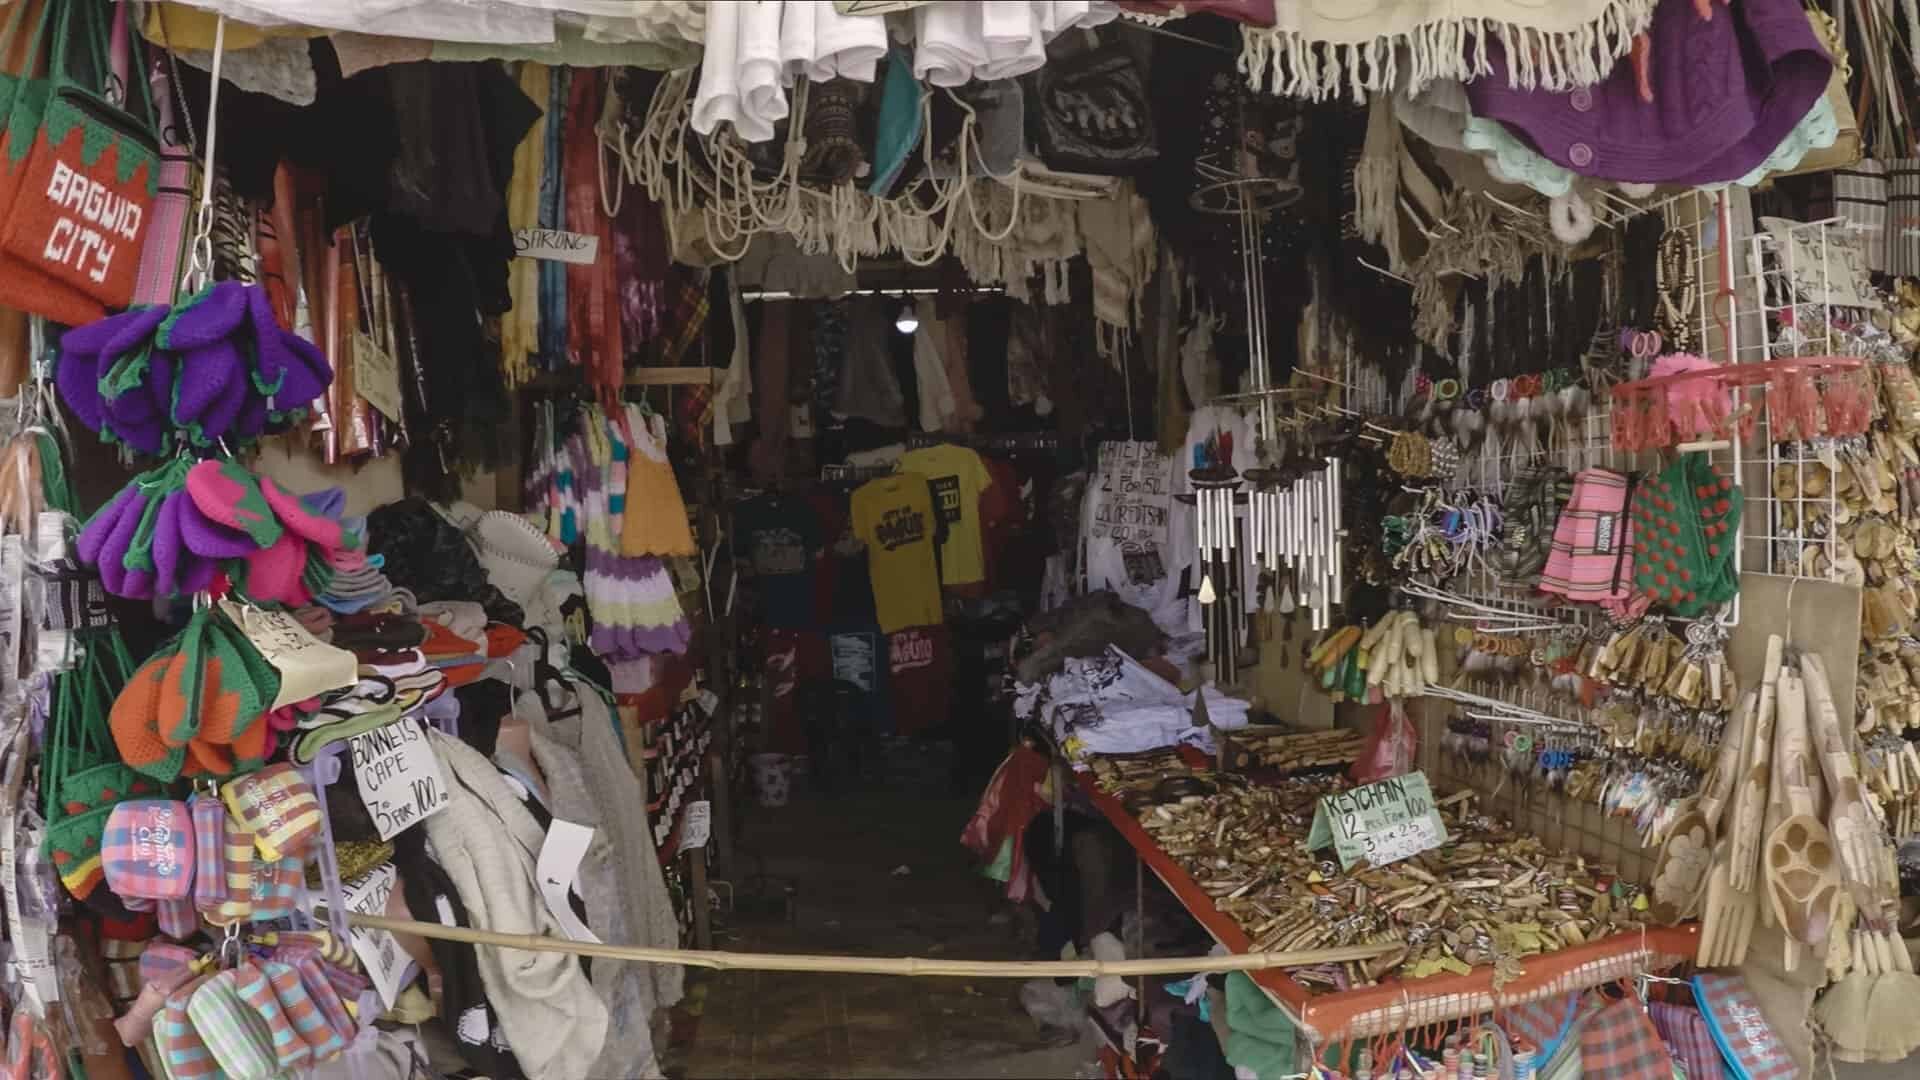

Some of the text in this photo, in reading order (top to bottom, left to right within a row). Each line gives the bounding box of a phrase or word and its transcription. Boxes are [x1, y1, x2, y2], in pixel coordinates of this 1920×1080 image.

[47, 160, 142, 241] BAGUIO
[43, 217, 116, 282] CITY
[513, 229, 589, 251] SARONG
[350, 719, 418, 769] BONNETS
[364, 751, 409, 792] CAPE
[367, 800, 393, 836] 3
[408, 775, 437, 817] 100
[1325, 776, 1407, 818] KEYCHAIN
